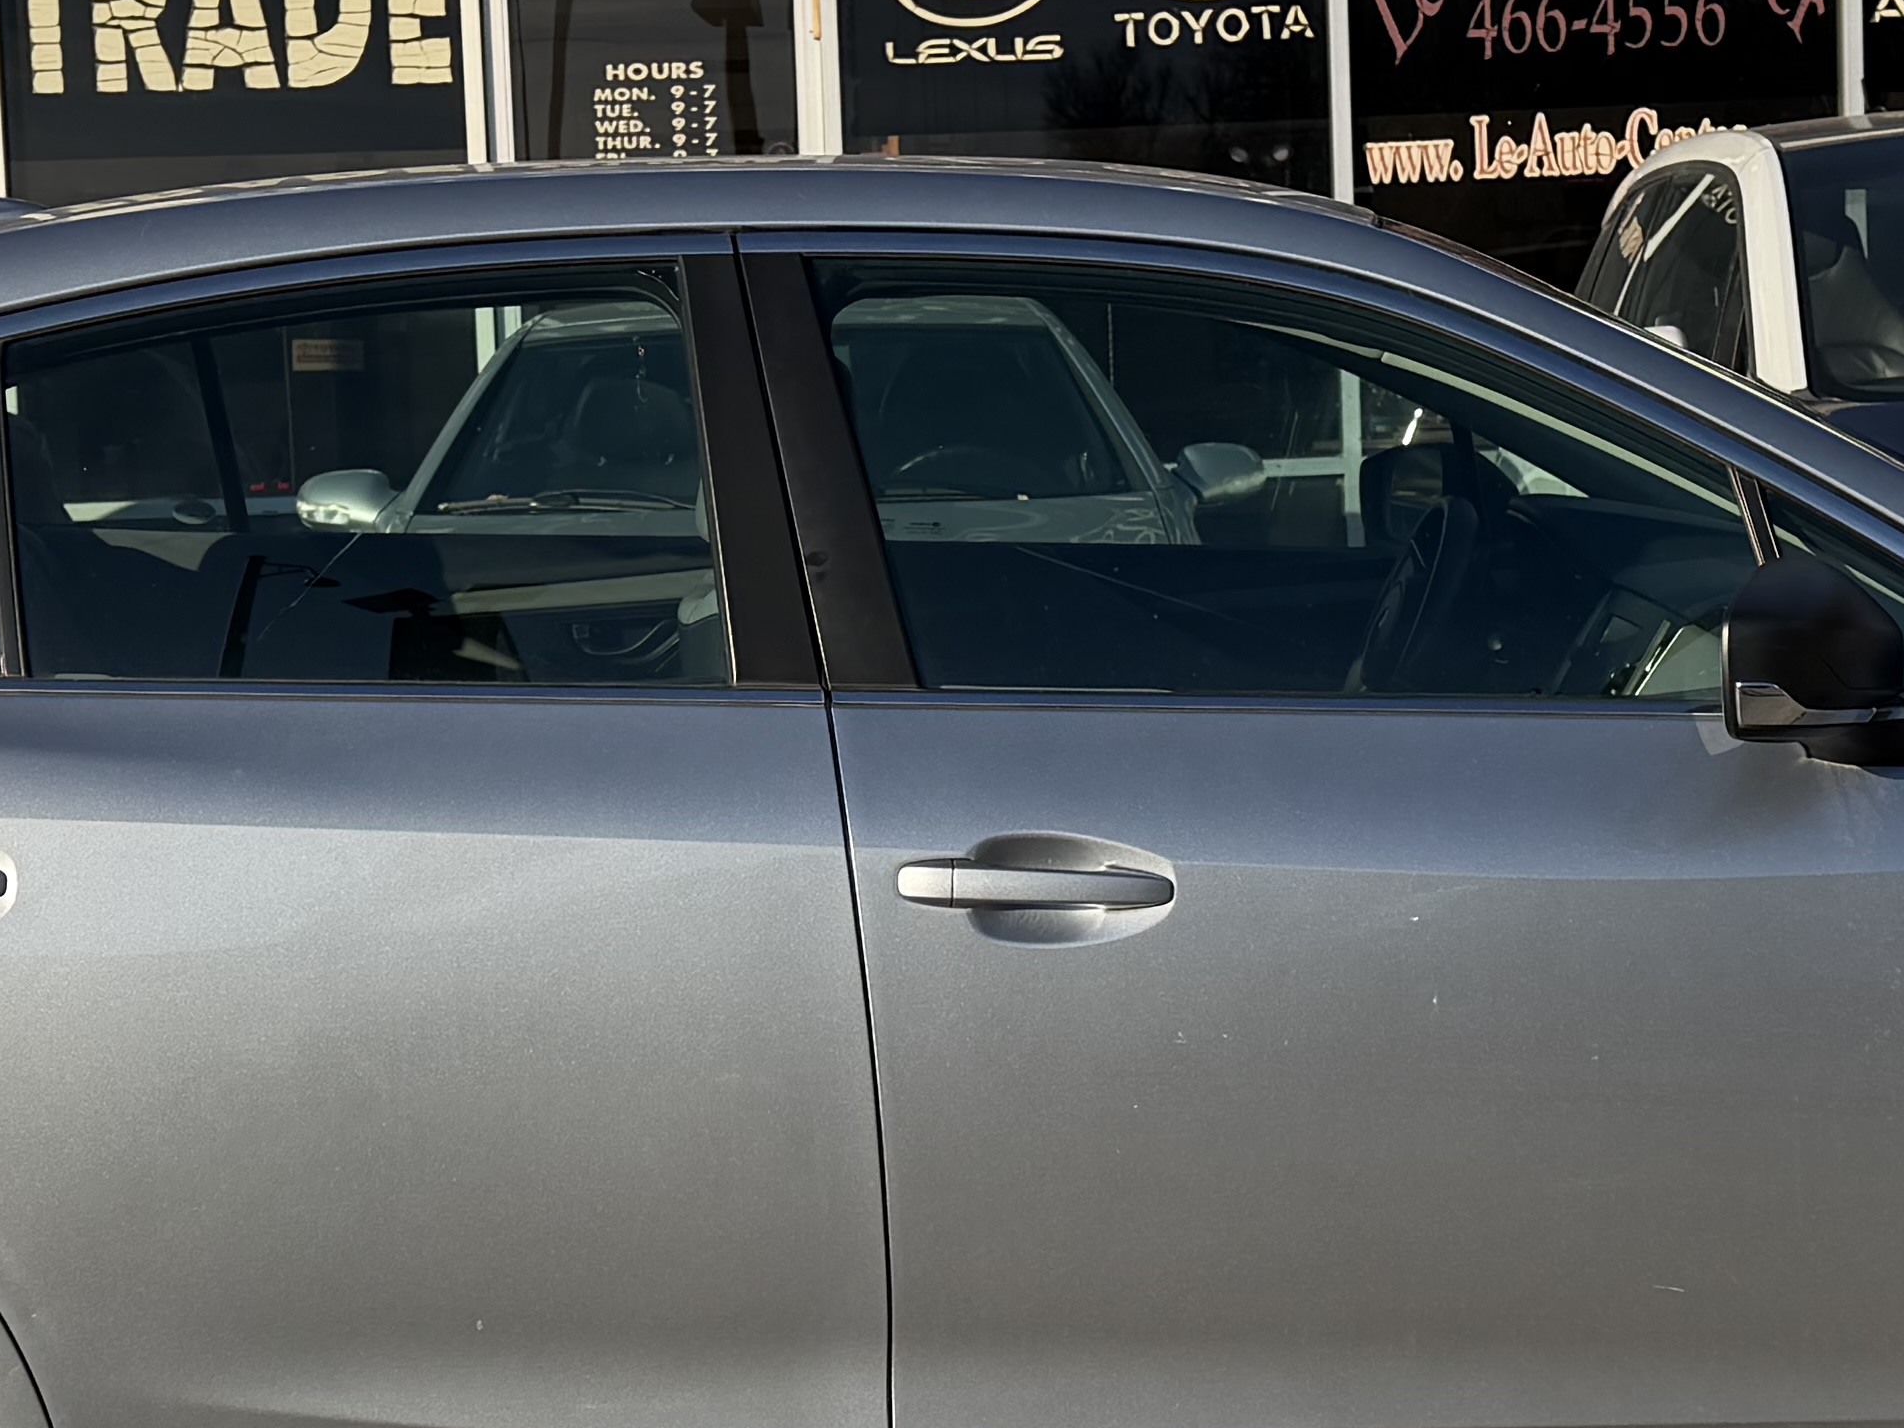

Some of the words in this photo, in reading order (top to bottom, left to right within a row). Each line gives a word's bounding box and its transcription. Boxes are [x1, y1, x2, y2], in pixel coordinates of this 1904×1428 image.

[1113, 4, 1316, 48] TOYOTA
[884, 34, 1065, 66] LEXUS
[605, 60, 705, 81] HOURS
[593, 86, 657, 102] MON.
[593, 103, 640, 119] TUE.
[594, 119, 651, 134] WED.
[595, 135, 662, 151] THUR.
[1364, 138, 1465, 185] www.
